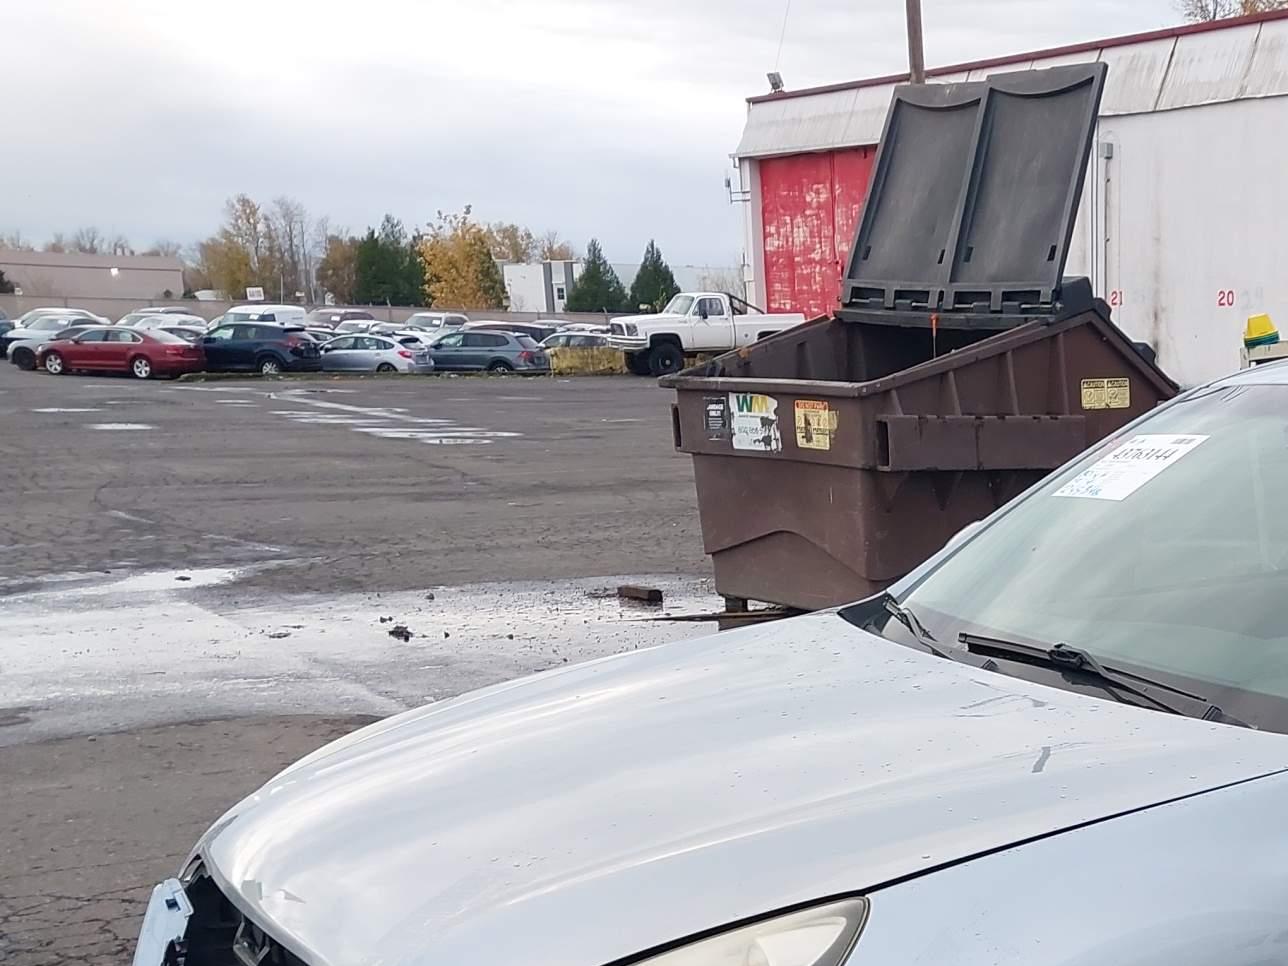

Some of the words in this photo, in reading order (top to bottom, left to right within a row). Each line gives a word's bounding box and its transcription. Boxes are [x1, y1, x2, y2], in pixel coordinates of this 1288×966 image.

[1111, 290, 1123, 306] 21
[1218, 290, 1235, 306] 20
[736, 394, 769, 413] WM
